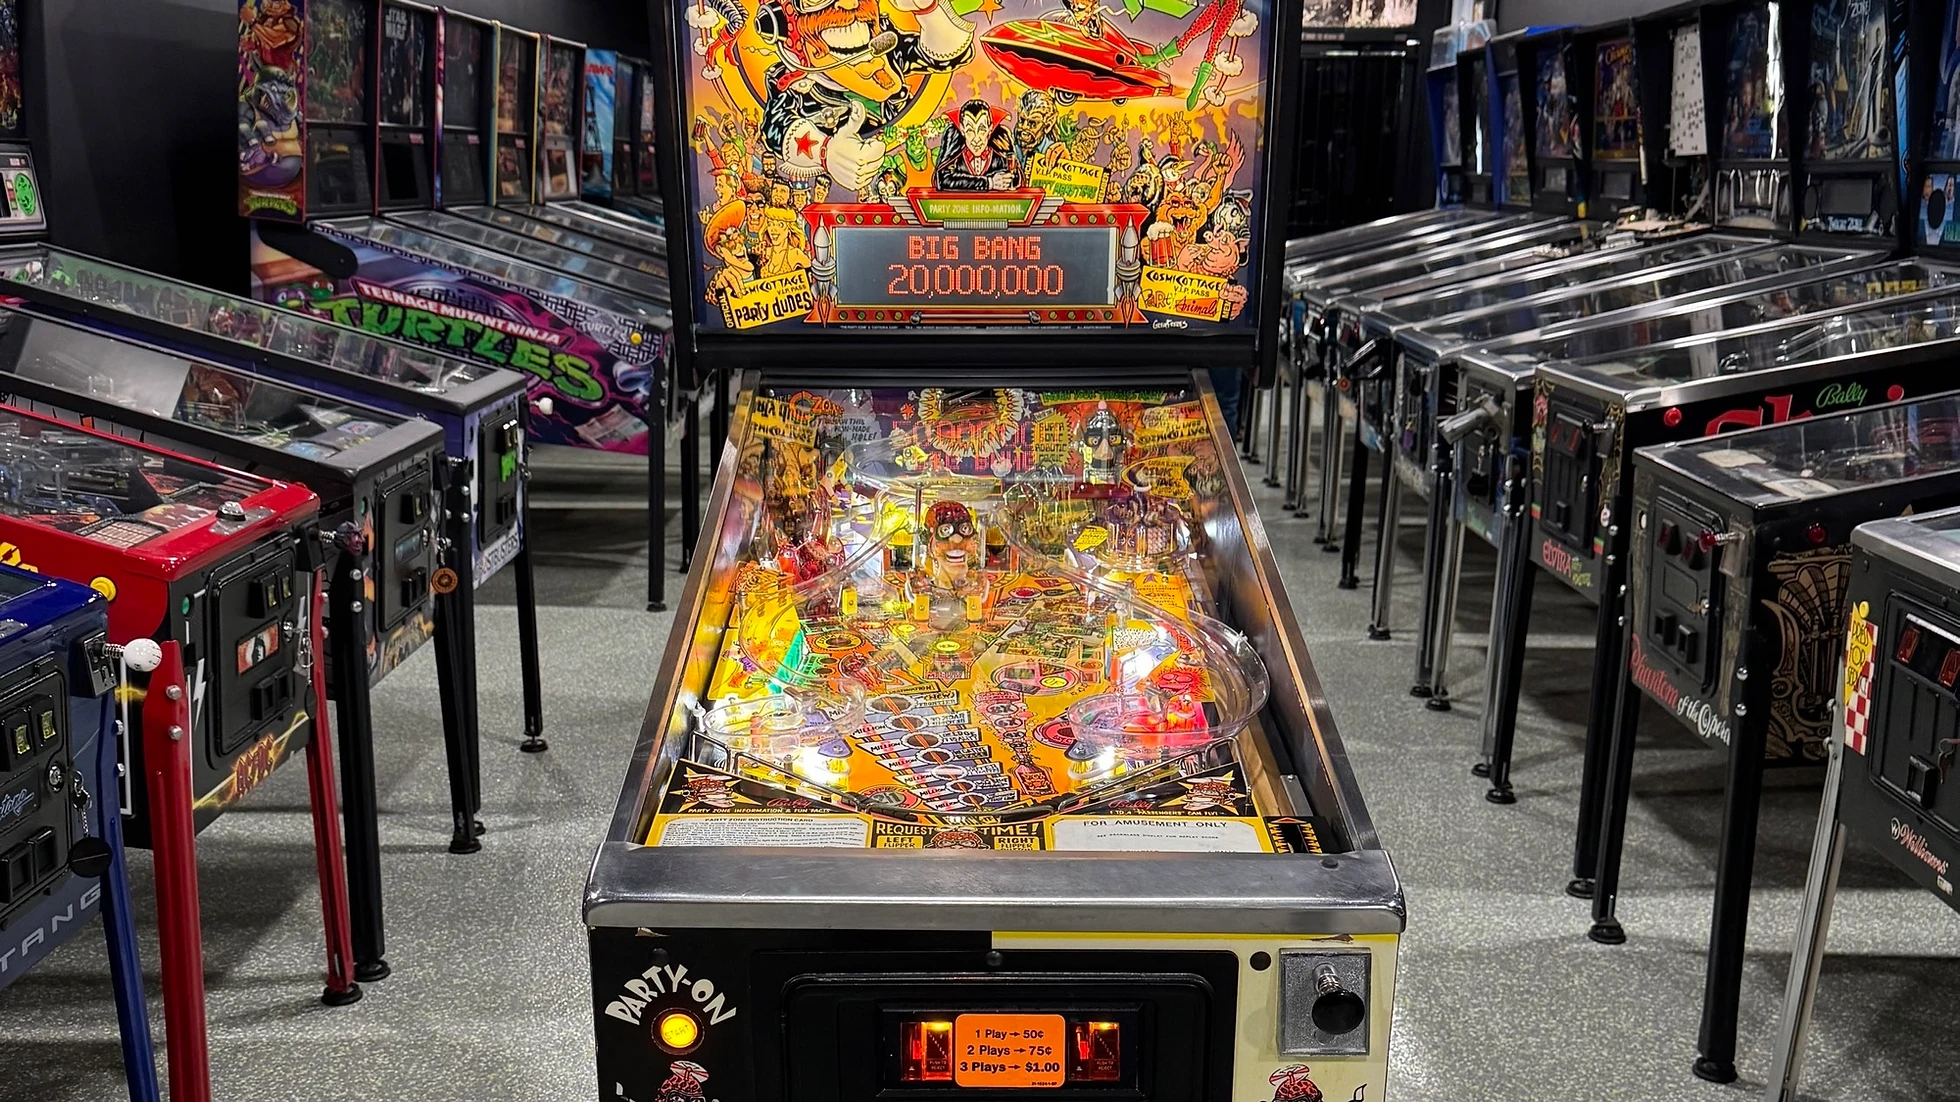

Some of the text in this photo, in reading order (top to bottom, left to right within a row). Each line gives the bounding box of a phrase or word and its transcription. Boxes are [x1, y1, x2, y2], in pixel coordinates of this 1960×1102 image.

[385, 6, 407, 23] STAR
[385, 21, 407, 40] WARS
[1053, 172, 1072, 182] PASS
[929, 203, 951, 214] PARTY
[952, 204, 969, 214] ZONE
[907, 235, 1041, 260] BIG BANG
[888, 264, 1064, 299] 20,000,000
[791, 285, 807, 294] PASS
[1191, 289, 1210, 298] PASS
[359, 282, 561, 346] TEENAGE MUTANT NINJA
[579, 320, 627, 344] TURTLES
[308, 297, 606, 401] TURTLES
[1815, 382, 1868, 408] Bally
[1040, 422, 1065, 431] SUPER
[851, 432, 878, 441] HOLE!
[1035, 443, 1067, 452] ROBOTIC
[853, 725, 886, 736] MILLION
[1697, 703, 1731, 746] Opera
[871, 742, 901, 752] MILLION
[888, 758, 917, 768] MILLION
[904, 774, 932, 784] MILLION
[920, 787, 946, 798] MILLION
[935, 800, 959, 810] MILLION
[1108, 800, 1154, 813] Bally
[876, 822, 935, 835] REQUEST
[979, 822, 1040, 836] TIME!
[604, 963, 737, 1026] PARTY-ON
[664, 1024, 690, 1040] START
[975, 1029, 1044, 1041] 1 Play 50¢
[967, 1045, 1052, 1057] 2 Plays 75¢
[960, 1061, 1060, 1074] 3 Plays $1.00
